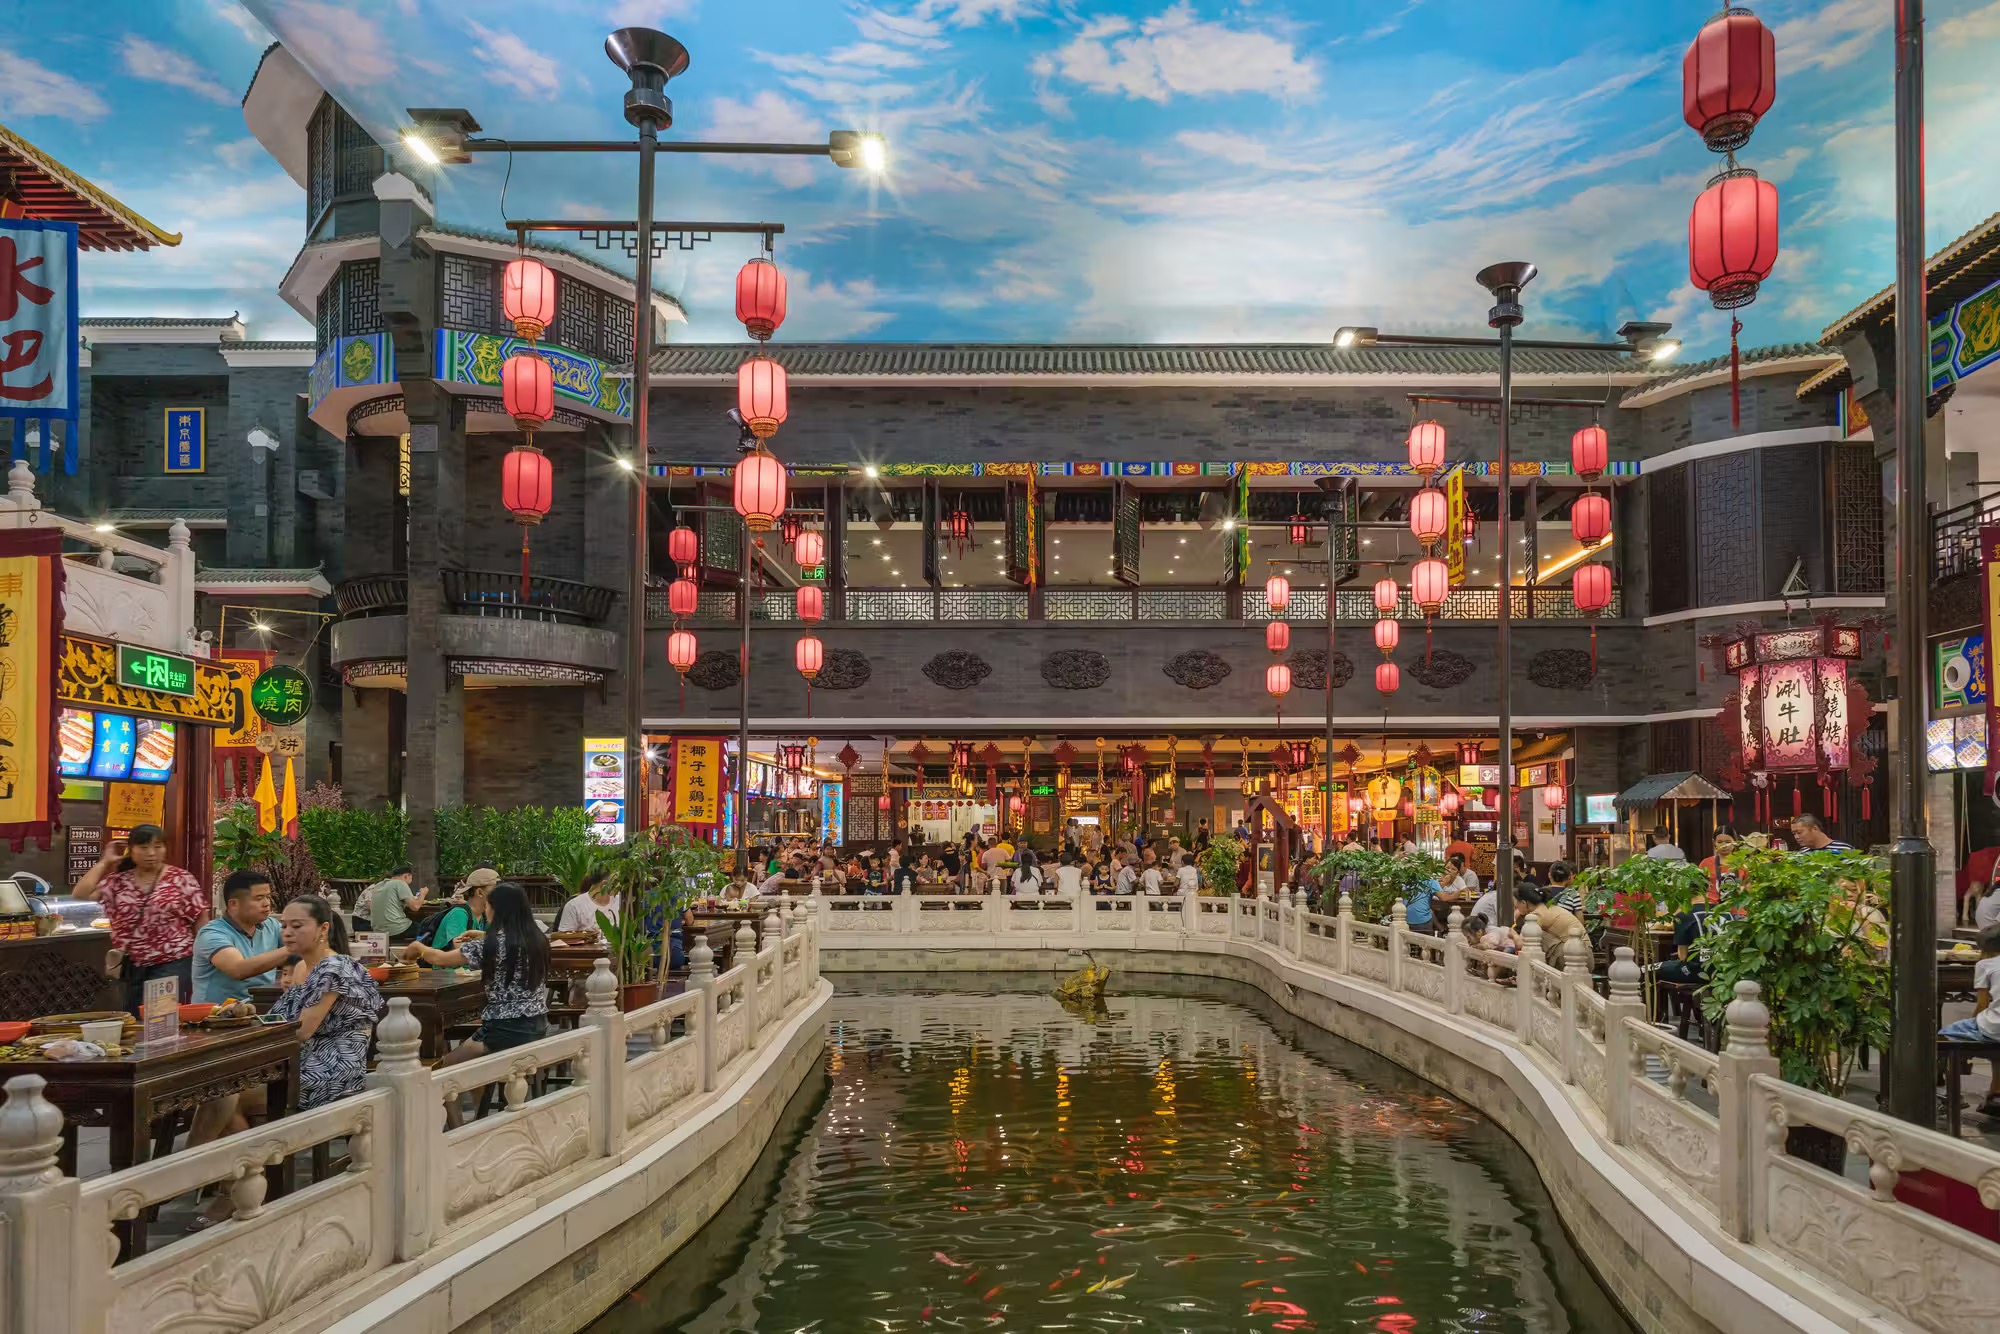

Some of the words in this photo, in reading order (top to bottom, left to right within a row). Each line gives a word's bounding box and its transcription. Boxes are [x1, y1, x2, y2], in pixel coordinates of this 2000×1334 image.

[171, 680, 185, 689] EXIT
[1775, 678, 1804, 747] 涮牛肚
